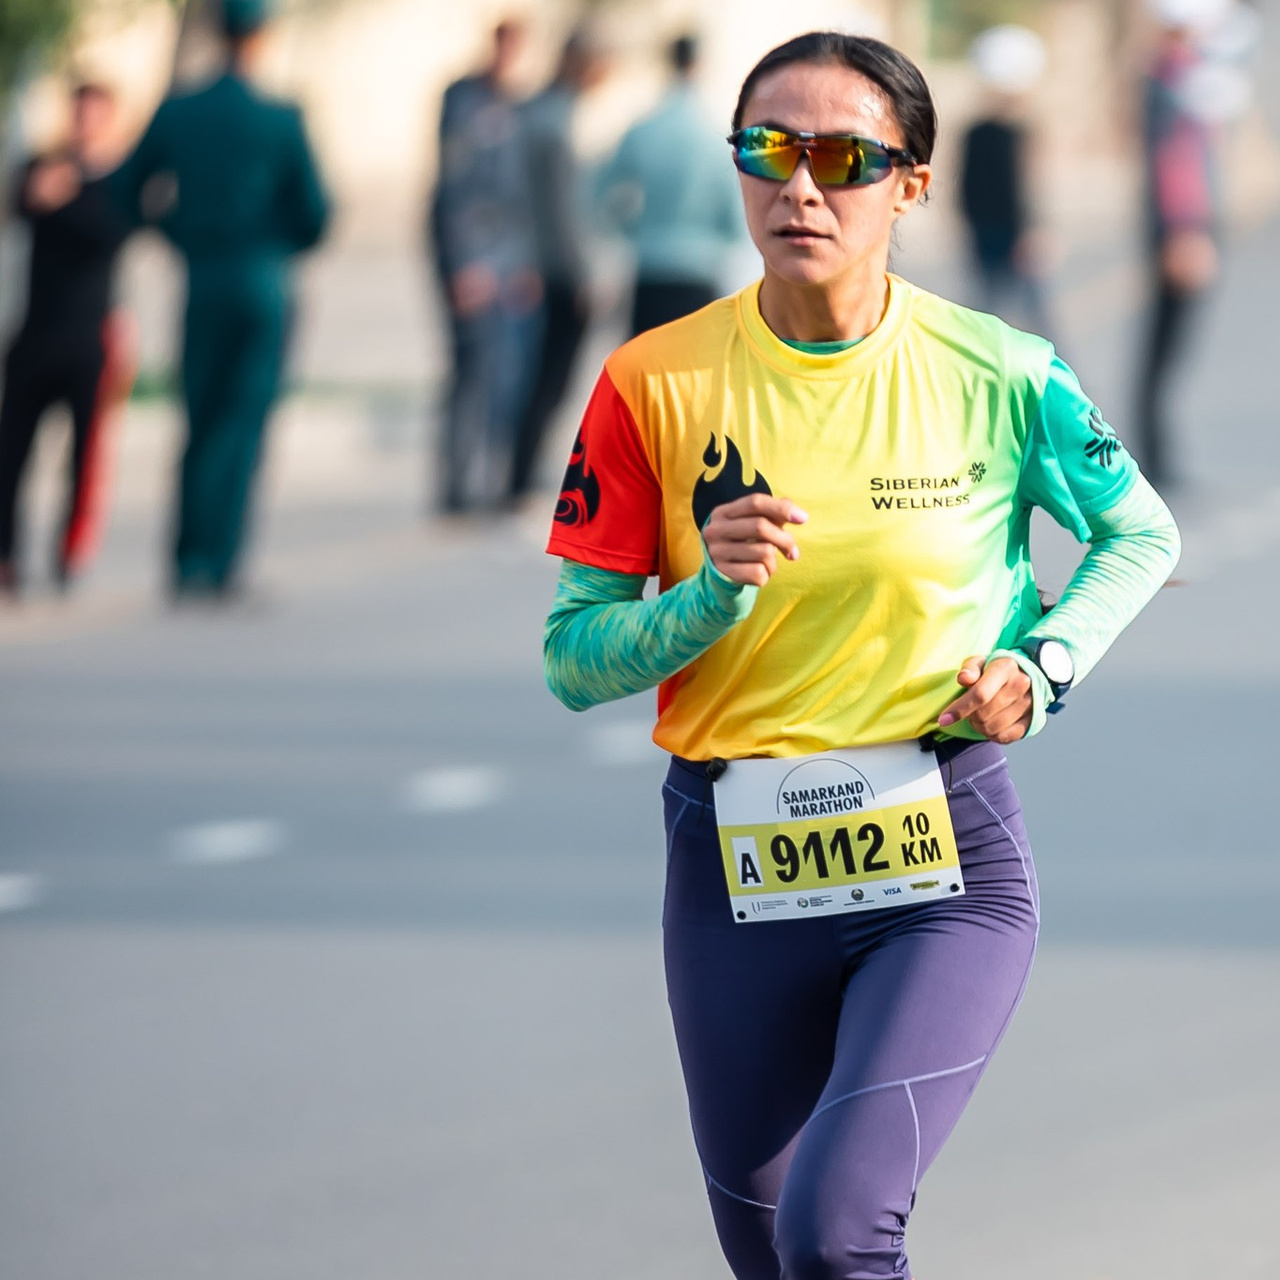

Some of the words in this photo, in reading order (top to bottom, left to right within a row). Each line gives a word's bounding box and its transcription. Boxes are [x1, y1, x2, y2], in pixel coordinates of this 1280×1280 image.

[782, 780, 864, 805] SAMARKAND
[790, 795, 863, 818] MARATHON
[902, 812, 930, 838] 10
[741, 852, 762, 885] A
[770, 822, 890, 883] 9112
[901, 837, 942, 867] KM
[882, 887, 902, 896] VISA
